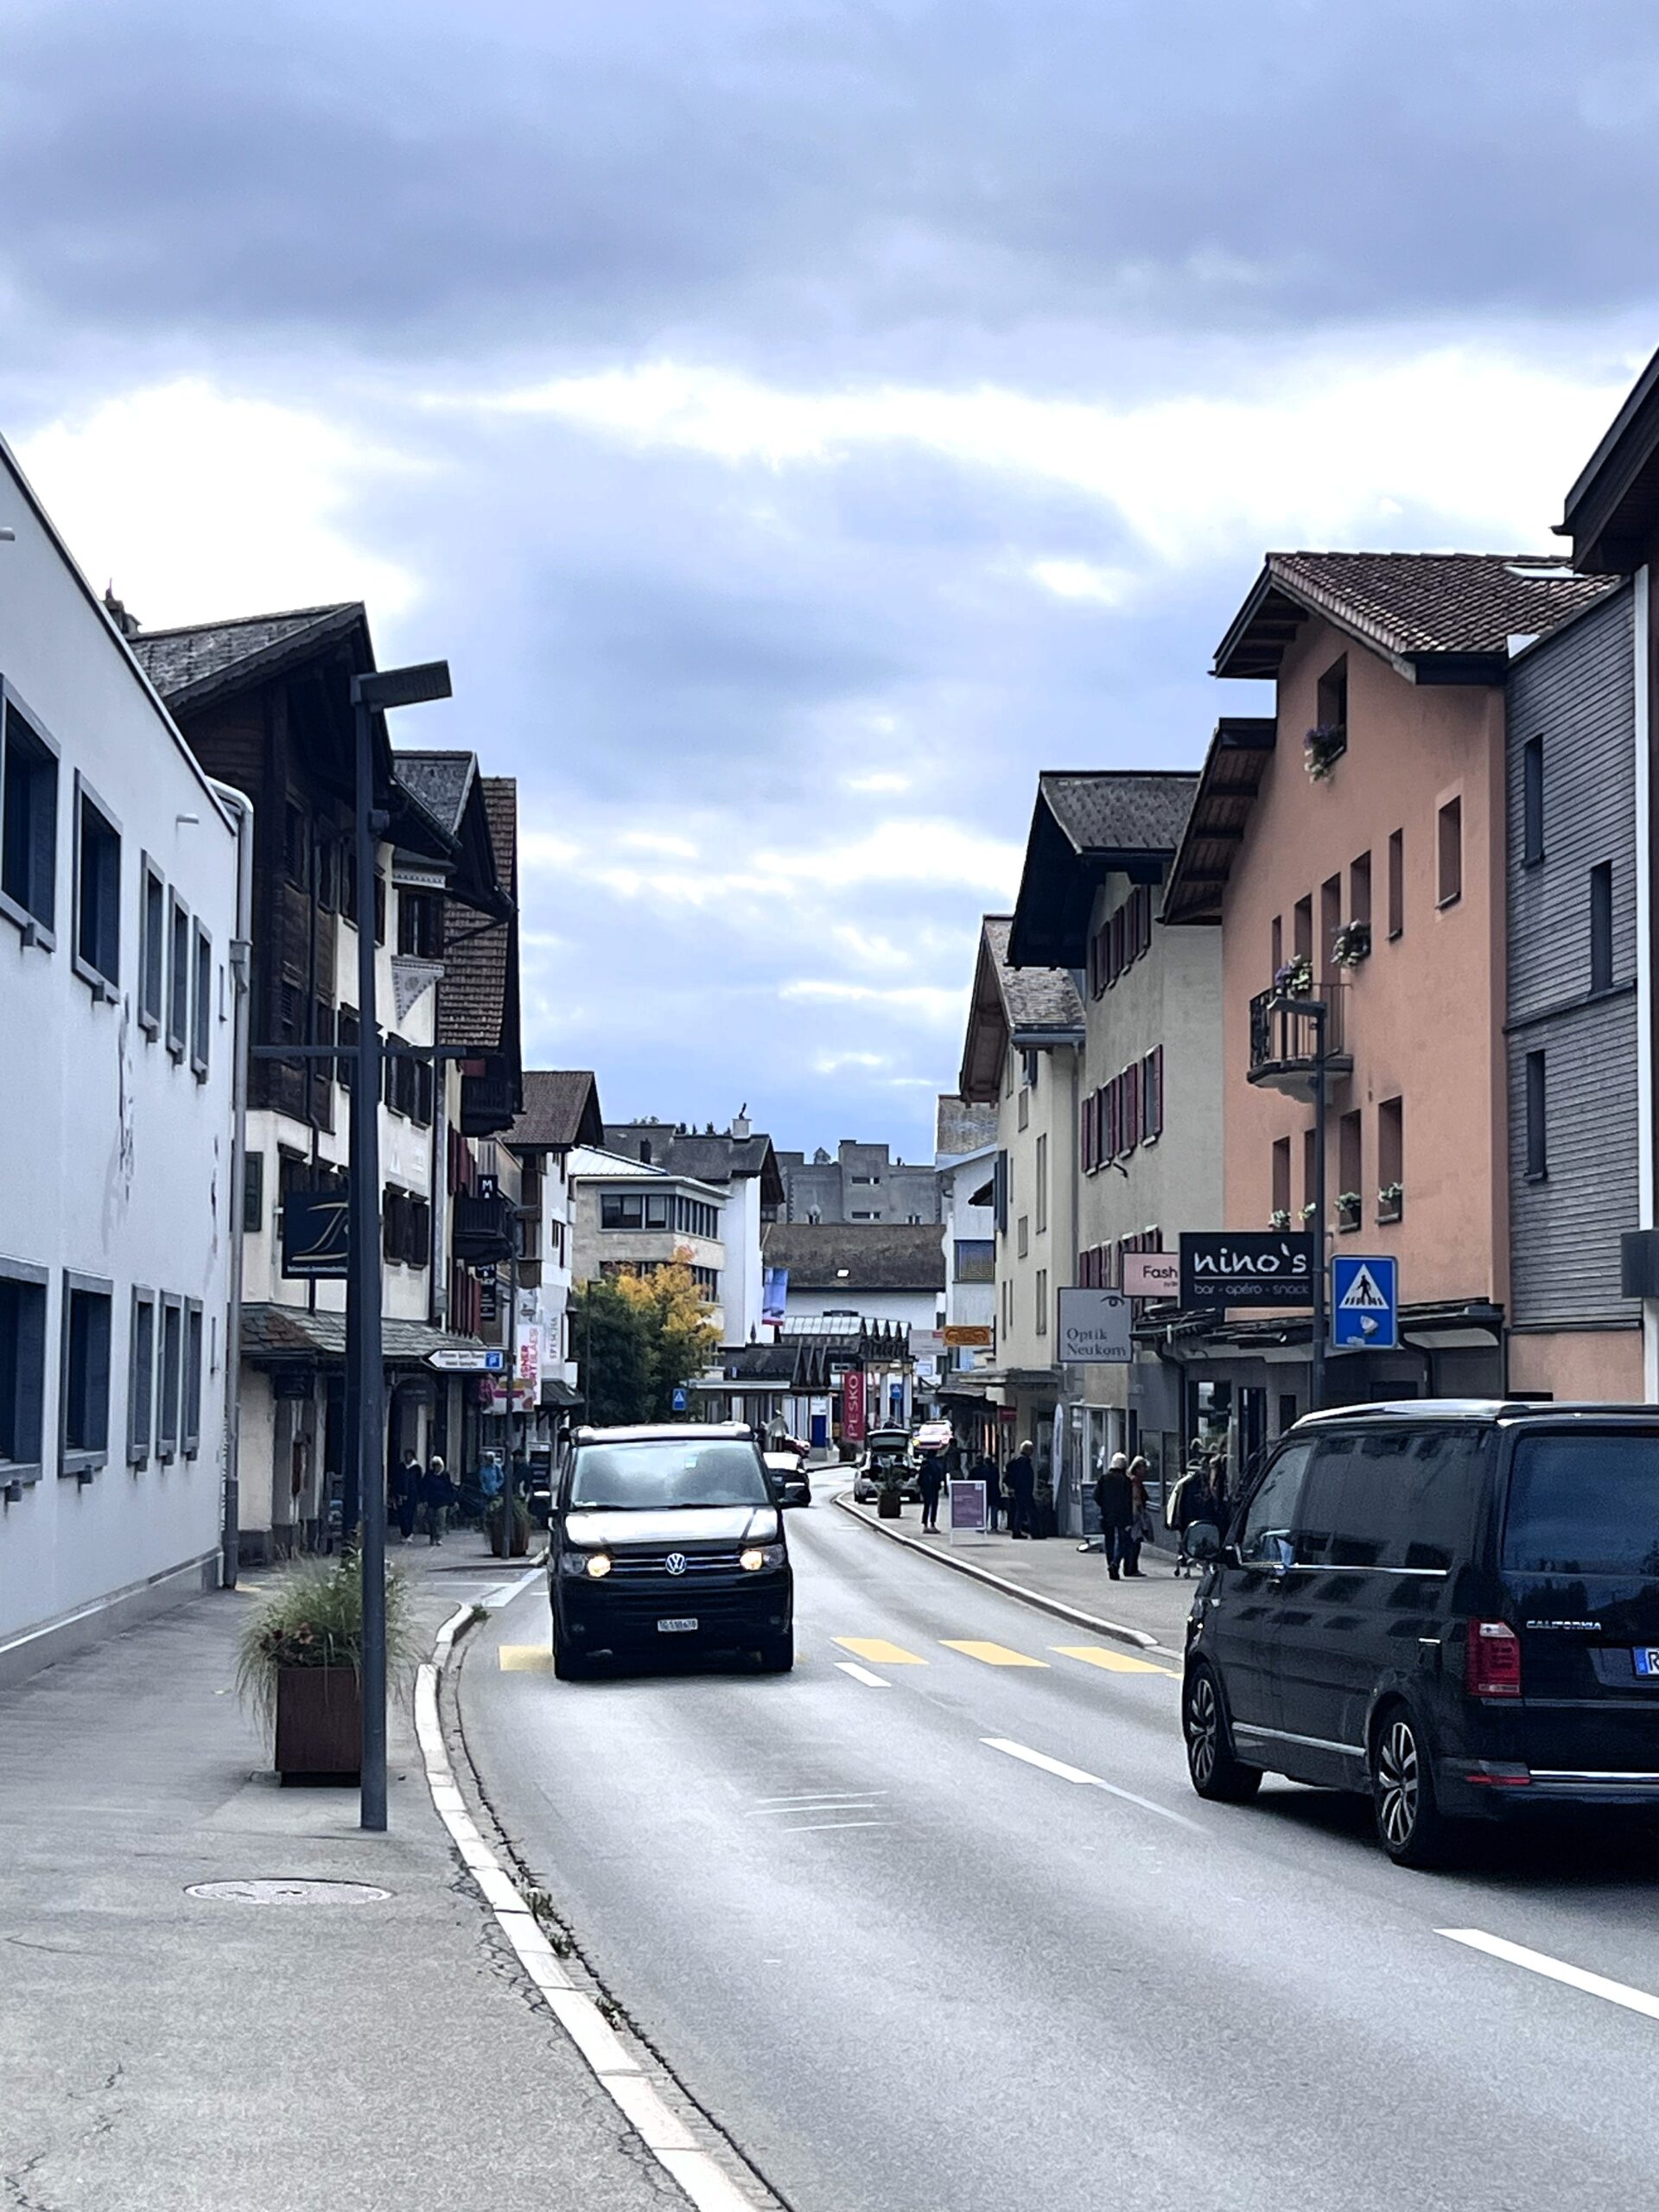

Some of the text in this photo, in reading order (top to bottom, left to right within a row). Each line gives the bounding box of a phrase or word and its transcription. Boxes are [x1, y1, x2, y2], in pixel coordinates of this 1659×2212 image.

[1194, 1243, 1307, 1274] nino's
[1194, 1283, 1215, 1294] bar
[1272, 1283, 1309, 1295] snack
[1066, 1327, 1108, 1343] Optik
[1066, 1342, 1127, 1357] Neukom
[848, 1375, 859, 1438] PESKO
